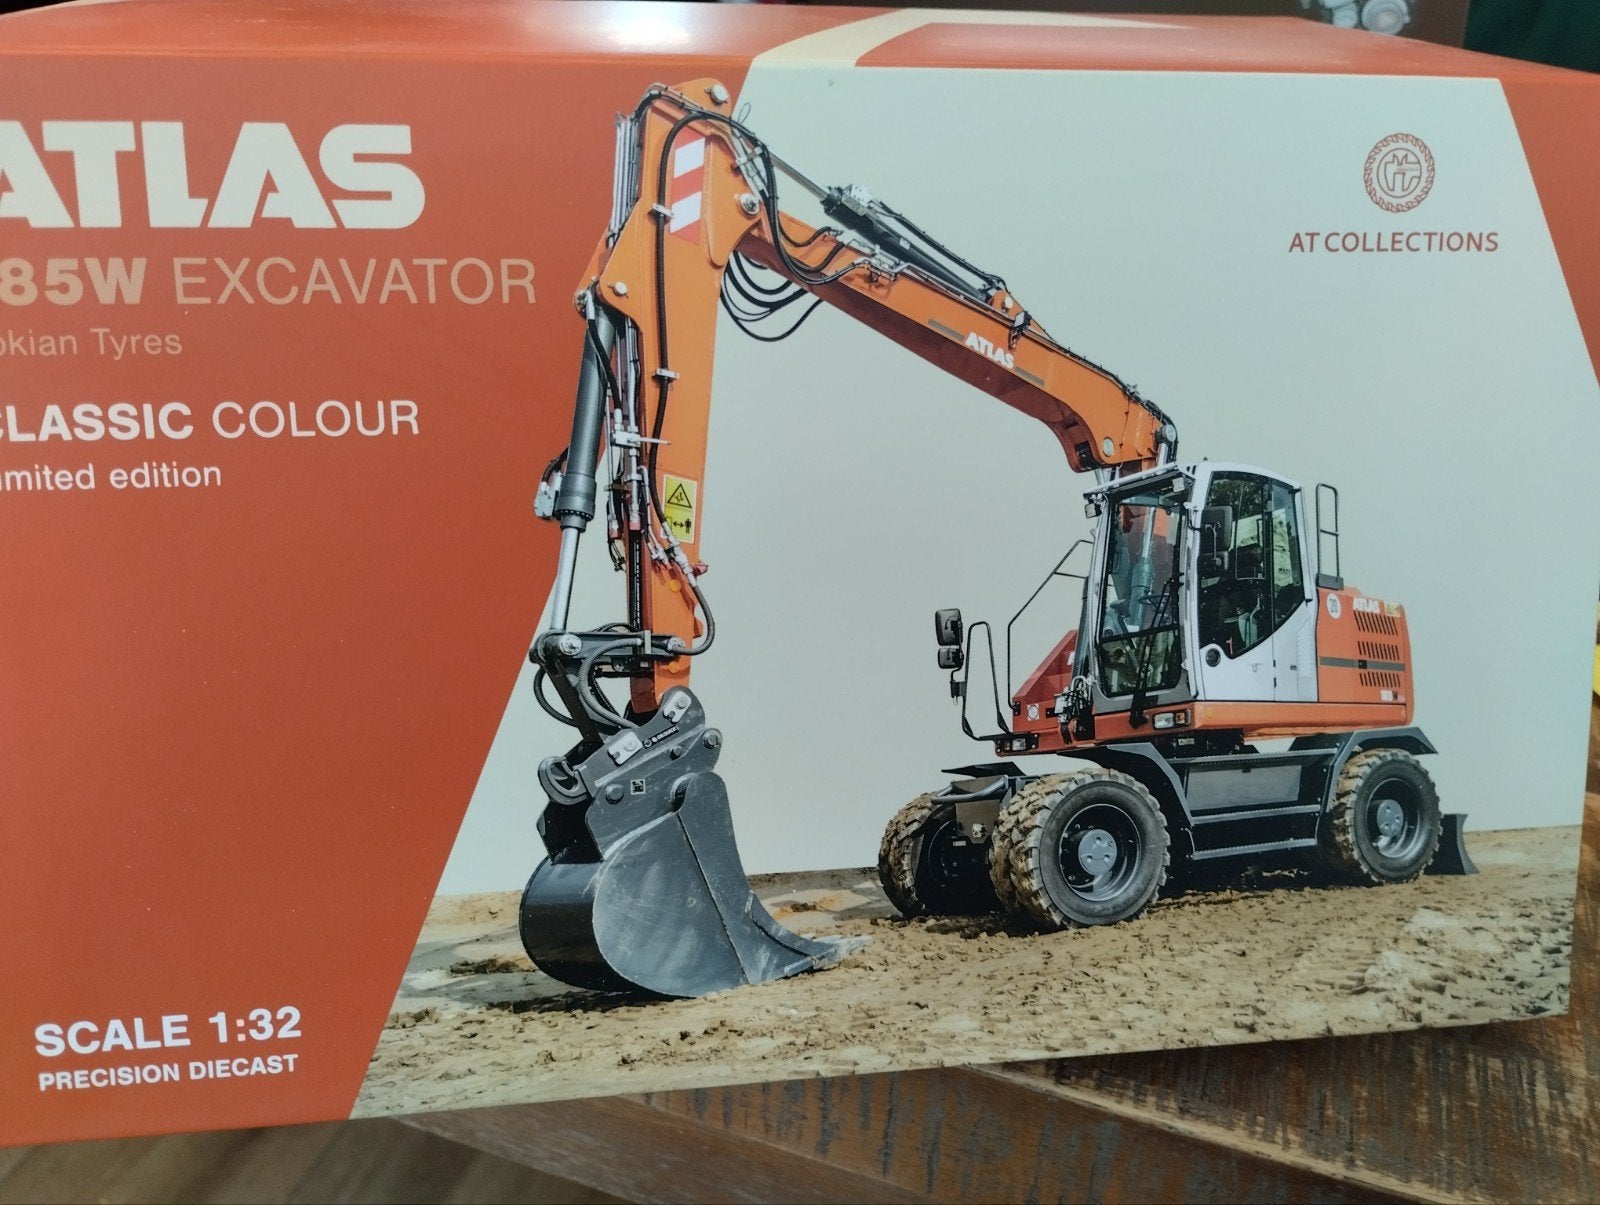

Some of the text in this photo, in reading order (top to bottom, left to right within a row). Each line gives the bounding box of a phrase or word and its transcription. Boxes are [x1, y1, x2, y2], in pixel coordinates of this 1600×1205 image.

[0, 120, 425, 229] ATLAS
[1288, 232, 1499, 252] AT COLLECTIONS
[174, 257, 536, 304] EXCAVATOR
[0, 328, 182, 360] kian Tyres
[965, 332, 1014, 369] ATLAS
[0, 400, 419, 442] LASSIC COLOUR
[109, 462, 221, 489] edition
[35, 1005, 302, 1057] SCALE 1:32
[38, 1054, 298, 1091] PRECISION DIECAST
